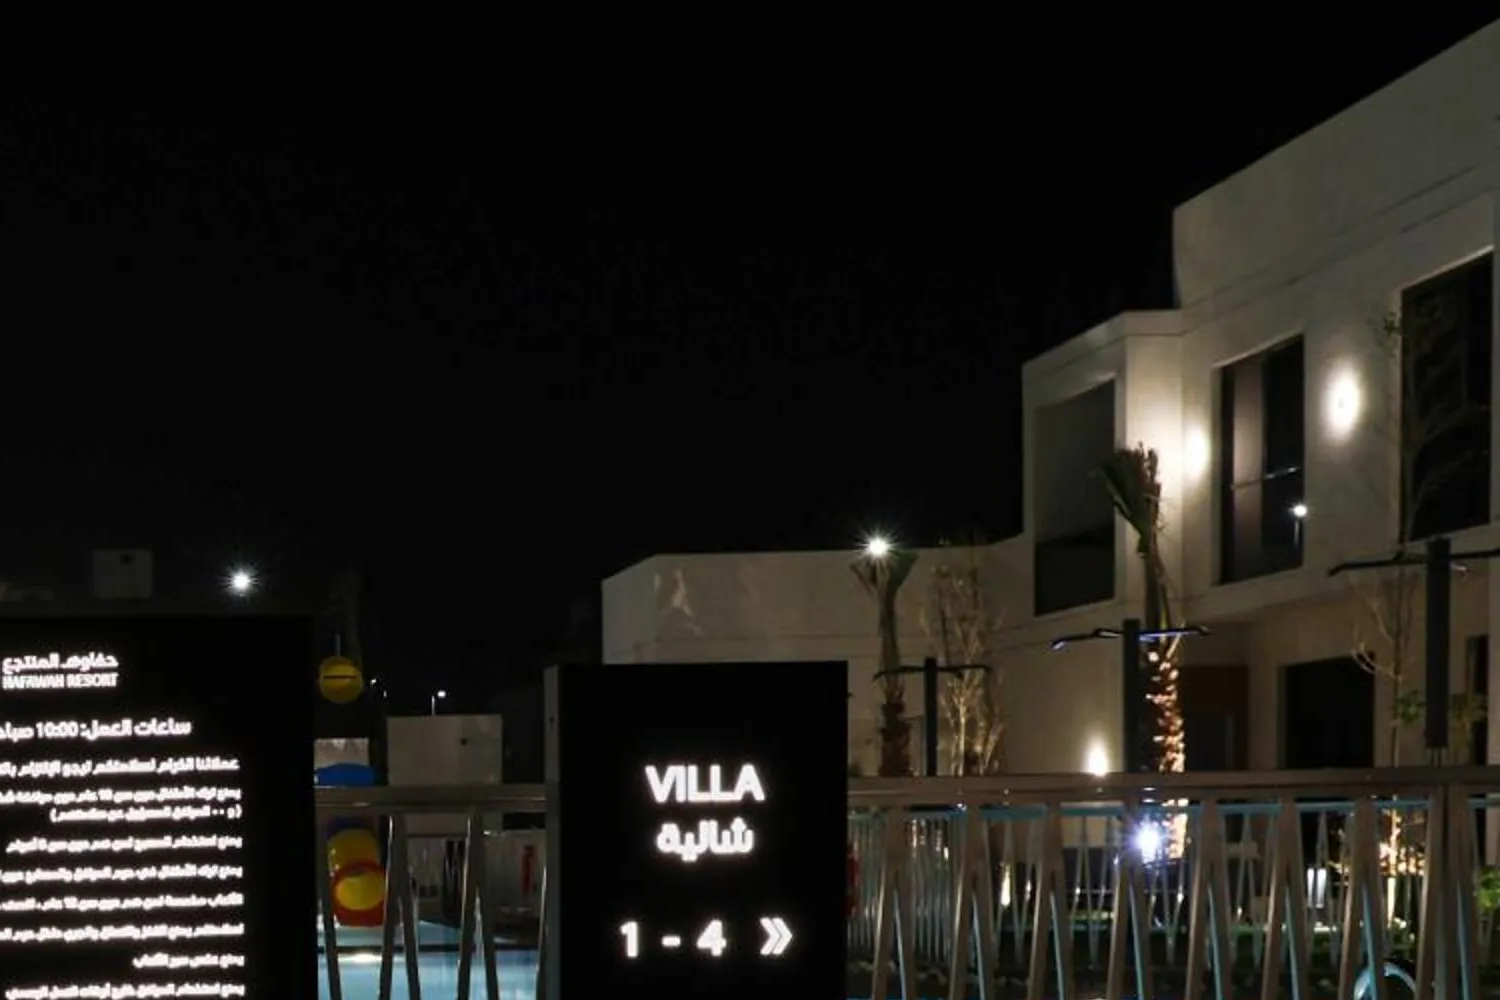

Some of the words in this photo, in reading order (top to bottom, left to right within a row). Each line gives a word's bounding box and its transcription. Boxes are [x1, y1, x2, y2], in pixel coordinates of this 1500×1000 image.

[2, 673, 64, 689] HAFAWAH
[67, 672, 119, 688] RESORT
[36, 722, 78, 737] 10:00
[645, 763, 765, 802] VILLA
[656, 817, 754, 862] شاليه
[619, 920, 639, 957] 1
[696, 919, 727, 956] 4
